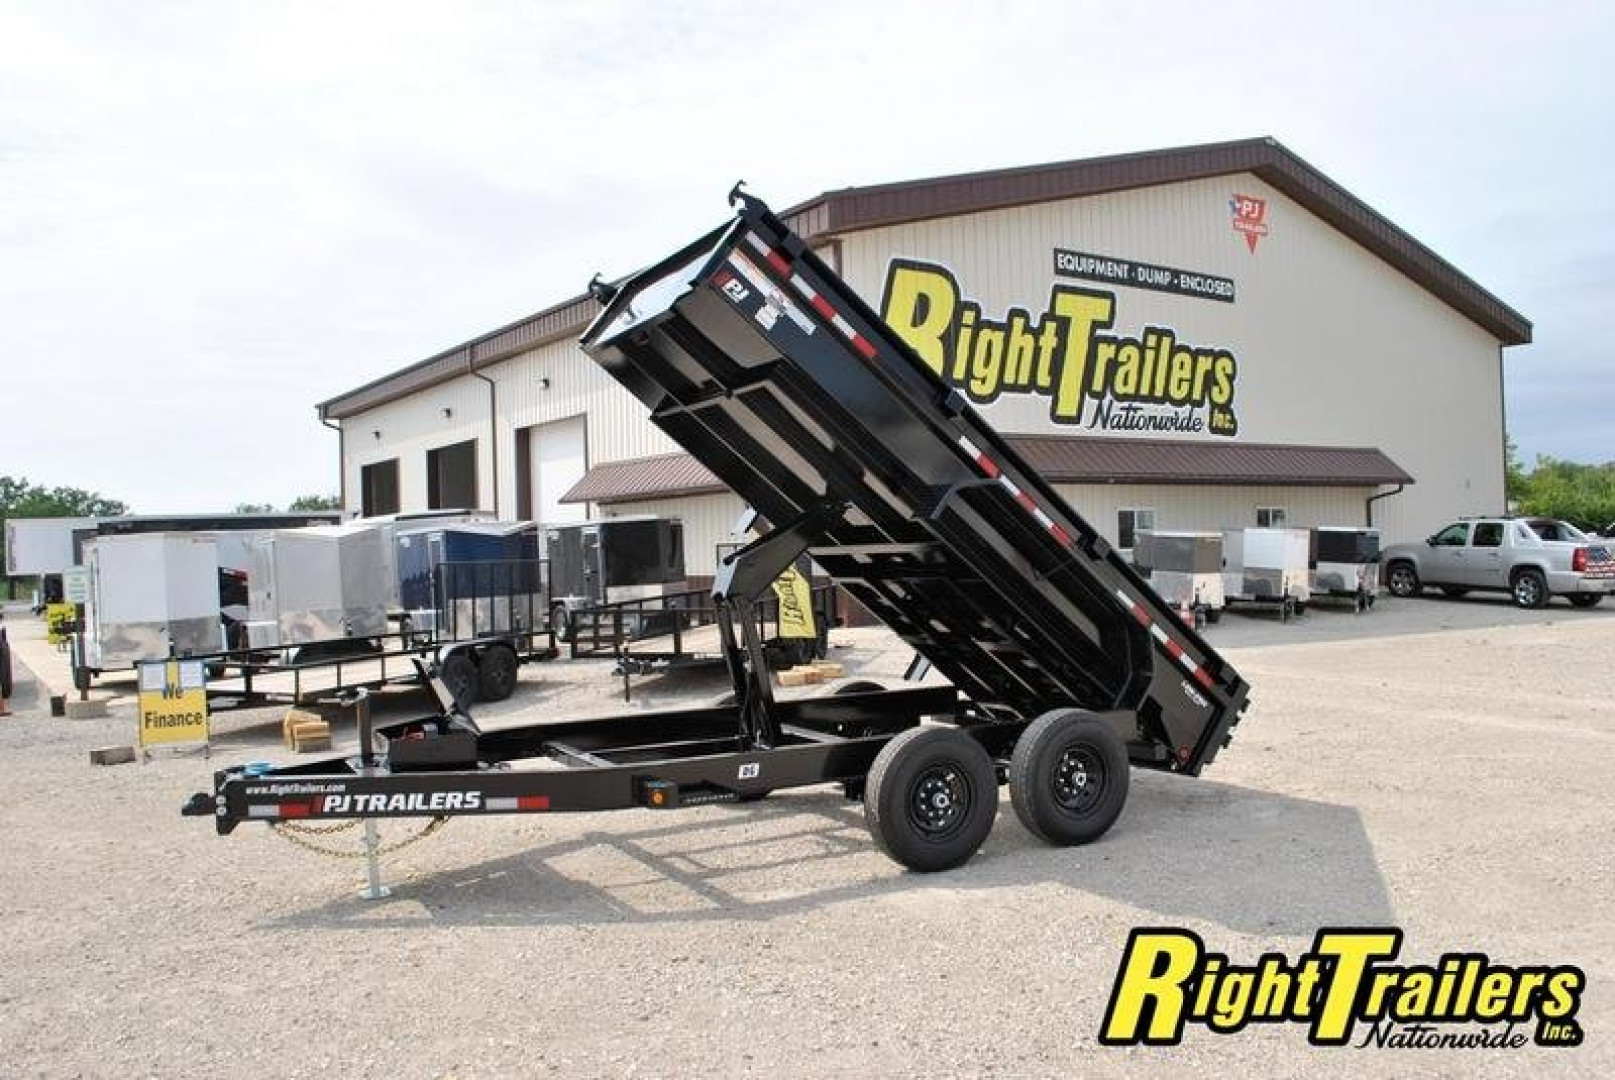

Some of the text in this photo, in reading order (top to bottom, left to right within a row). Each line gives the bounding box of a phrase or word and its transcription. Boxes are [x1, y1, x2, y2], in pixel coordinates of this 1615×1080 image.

[1057, 253, 1233, 296] EQUIPMENT DUMP ENCLOSED
[1089, 401, 1204, 433] Nationwide
[163, 683, 184, 699] We
[145, 710, 203, 729] Finance
[322, 791, 482, 812] PJ TRAILERS
